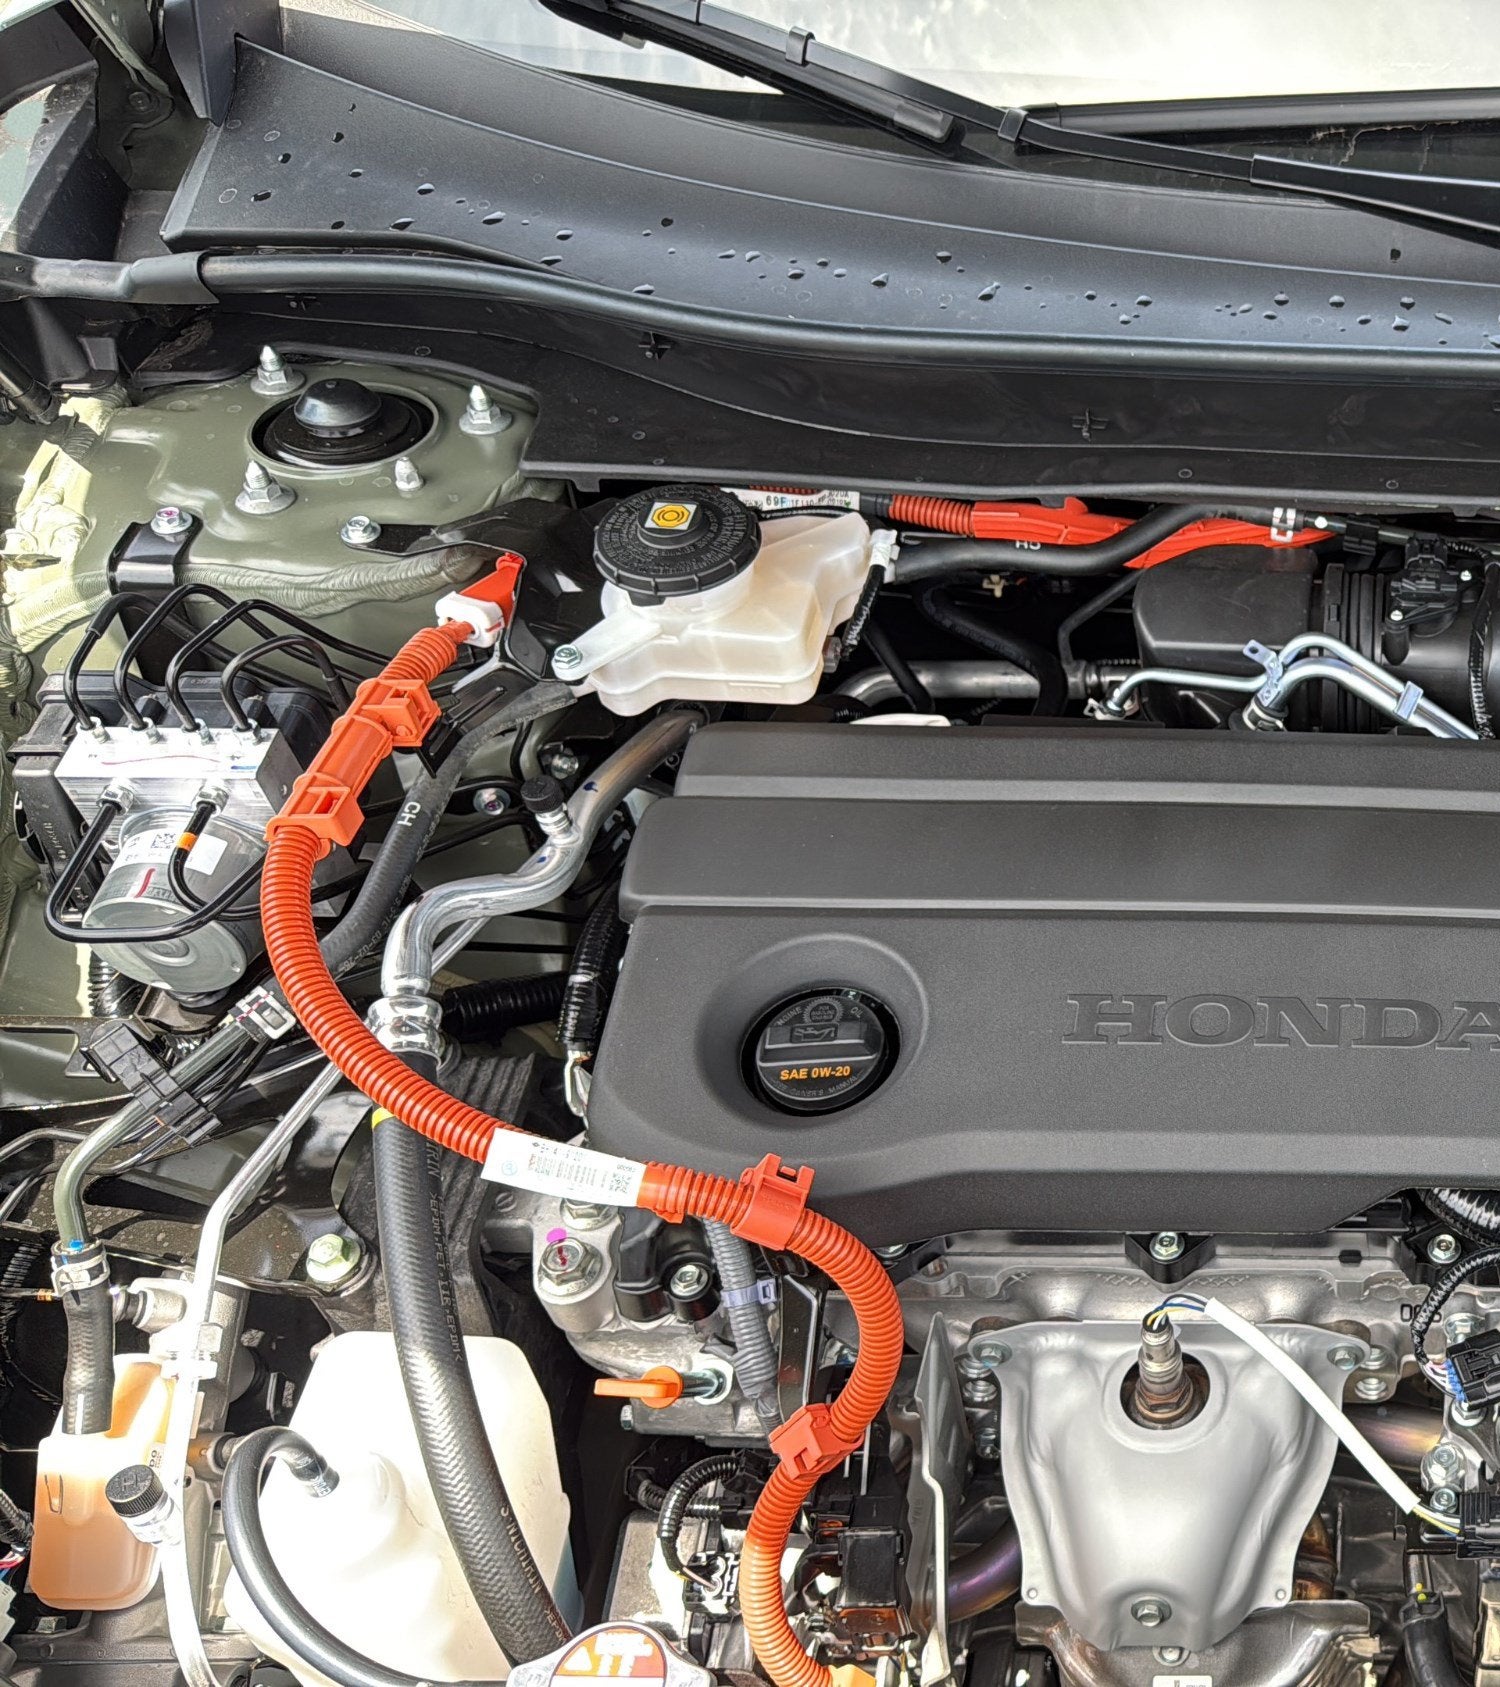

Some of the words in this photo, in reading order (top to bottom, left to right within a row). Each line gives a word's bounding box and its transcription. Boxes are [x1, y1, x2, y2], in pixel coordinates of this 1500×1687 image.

[396, 802, 421, 826] CH
[776, 1005, 803, 1025] NGINE
[779, 1068, 808, 1080] SAE
[810, 1065, 851, 1078] 0W-20
